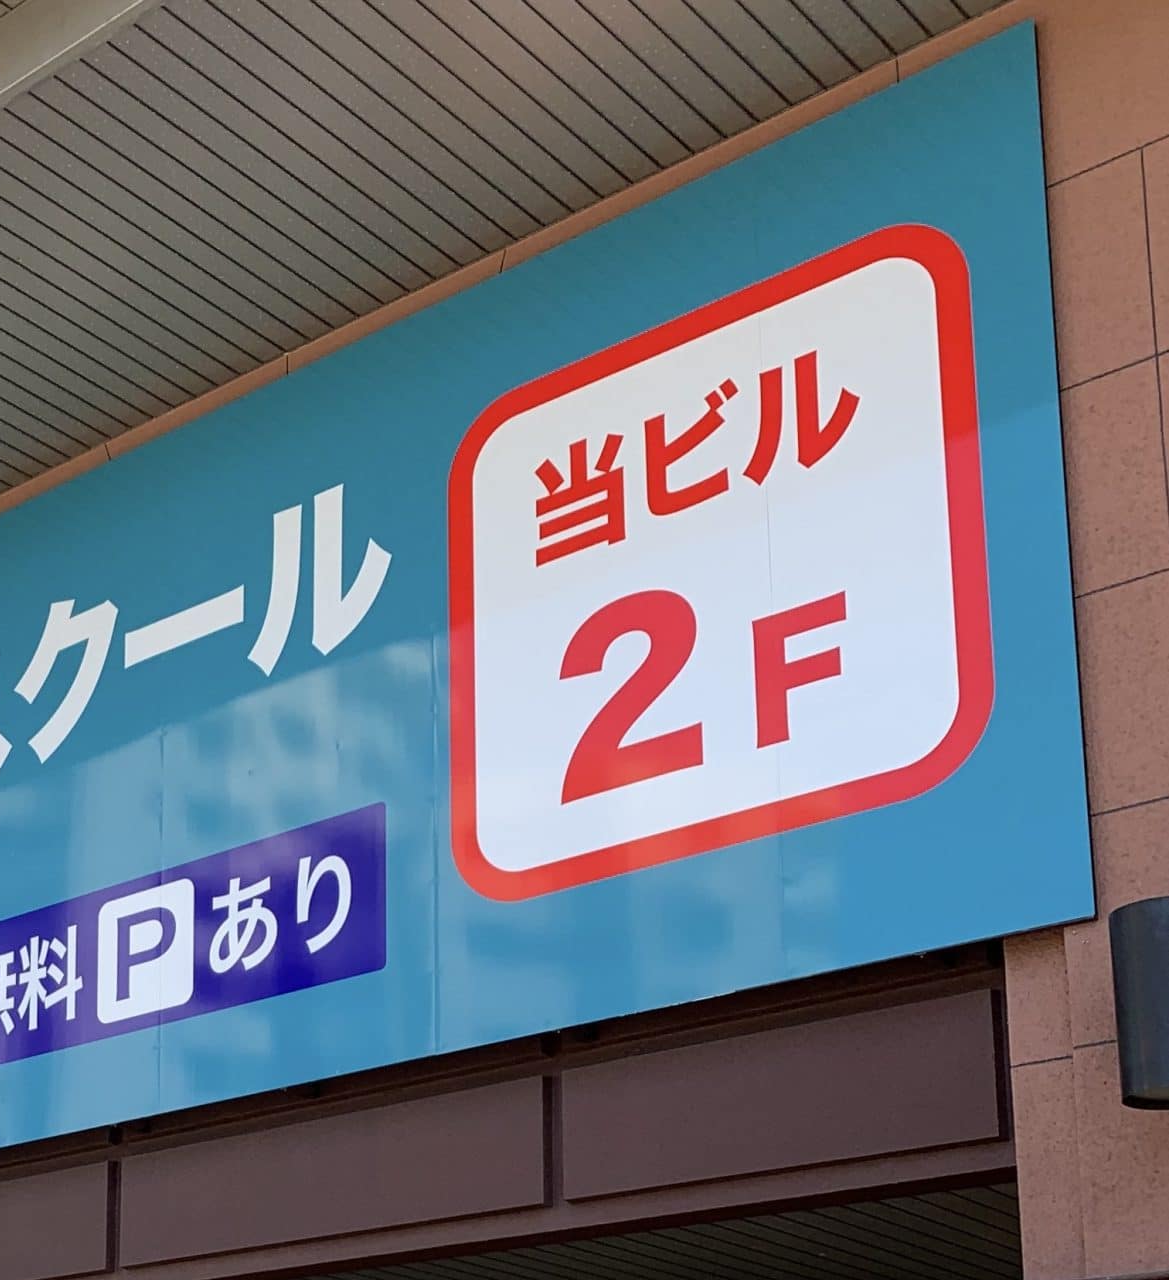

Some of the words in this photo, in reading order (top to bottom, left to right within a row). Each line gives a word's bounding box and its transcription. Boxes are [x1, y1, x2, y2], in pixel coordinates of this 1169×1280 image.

[534, 349, 861, 567] 当ビル
[559, 589, 848, 805] 2F
